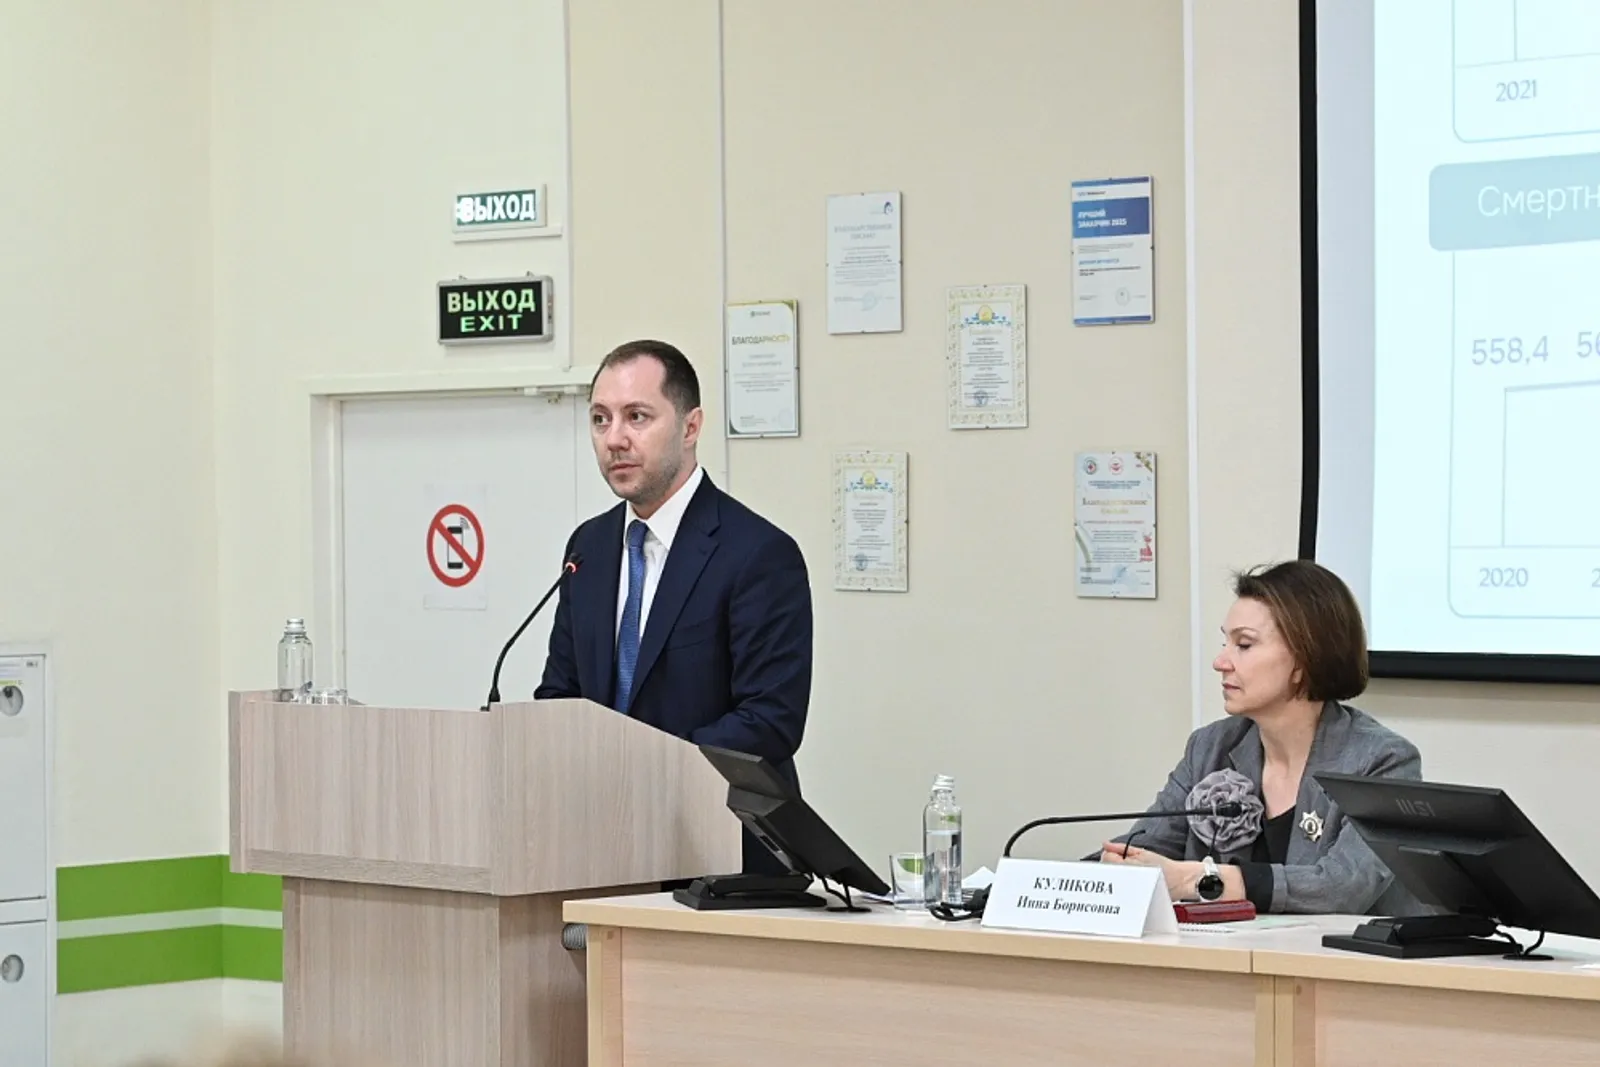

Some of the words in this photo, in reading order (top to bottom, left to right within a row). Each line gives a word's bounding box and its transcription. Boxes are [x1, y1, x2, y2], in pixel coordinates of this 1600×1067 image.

[1496, 79, 1538, 102] 2021
[457, 193, 536, 223] ВЫХОД
[1478, 185, 1600, 220] Смертн
[447, 288, 536, 313] ВЫХОД
[460, 314, 523, 333] EXIT
[1471, 335, 1550, 366] 558,4
[1479, 567, 1529, 588] 2020
[1033, 876, 1114, 895] КУЛИКОВА
[1053, 898, 1121, 915] Борисовна
